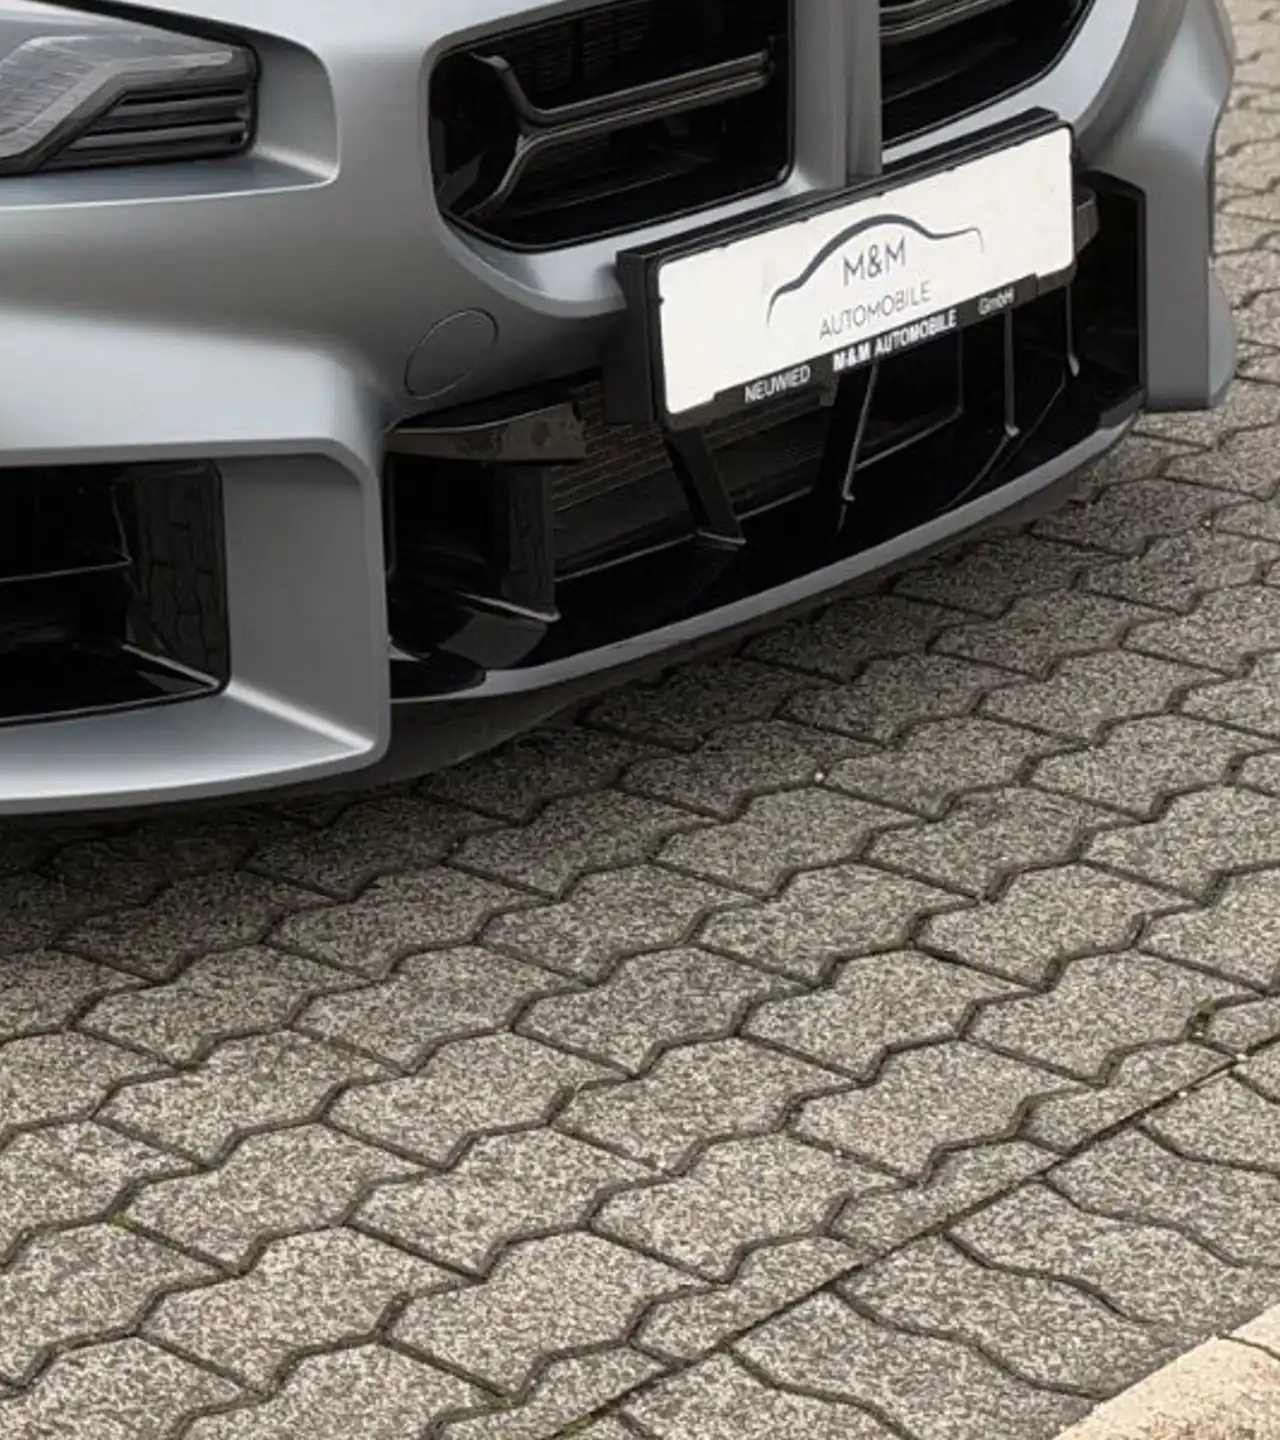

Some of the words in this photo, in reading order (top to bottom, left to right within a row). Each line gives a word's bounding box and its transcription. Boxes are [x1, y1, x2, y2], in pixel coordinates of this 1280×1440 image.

[842, 236, 906, 287] M&M
[819, 279, 931, 340] AUTOMOBILE
[874, 308, 959, 356] AUTOMOBILE
